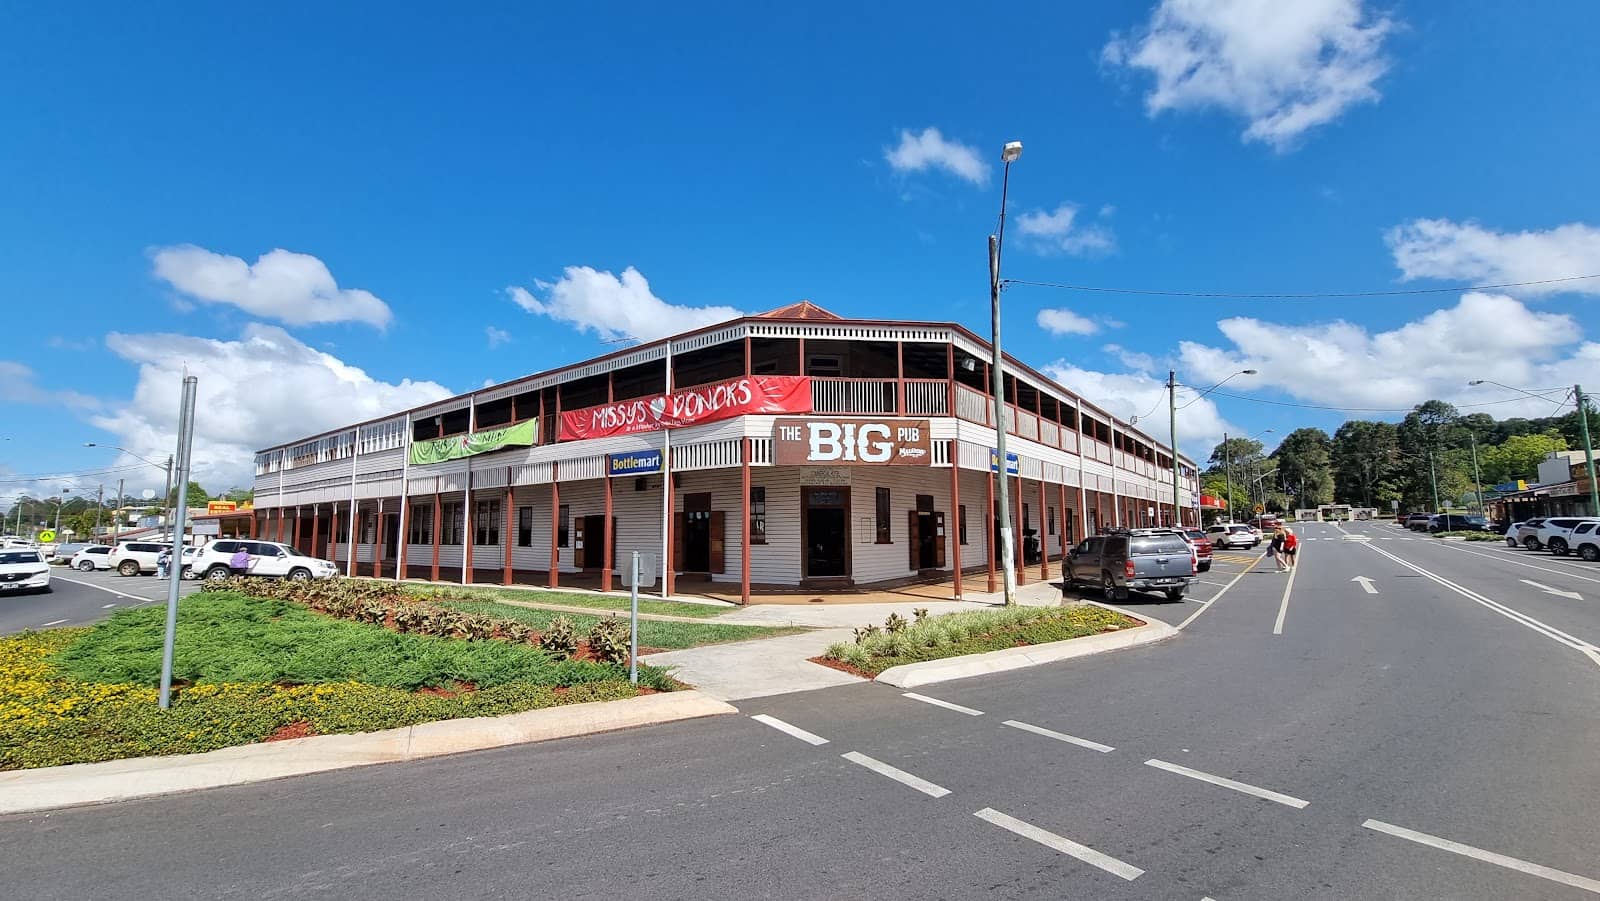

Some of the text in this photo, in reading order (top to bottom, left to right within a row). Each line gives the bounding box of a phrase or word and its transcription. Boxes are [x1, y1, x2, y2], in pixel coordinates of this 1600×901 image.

[673, 380, 752, 417] DONORS
[779, 426, 801, 441] THE
[806, 422, 894, 462] BIG
[897, 427, 920, 442] PUB
[612, 455, 660, 470] Bottlemart
